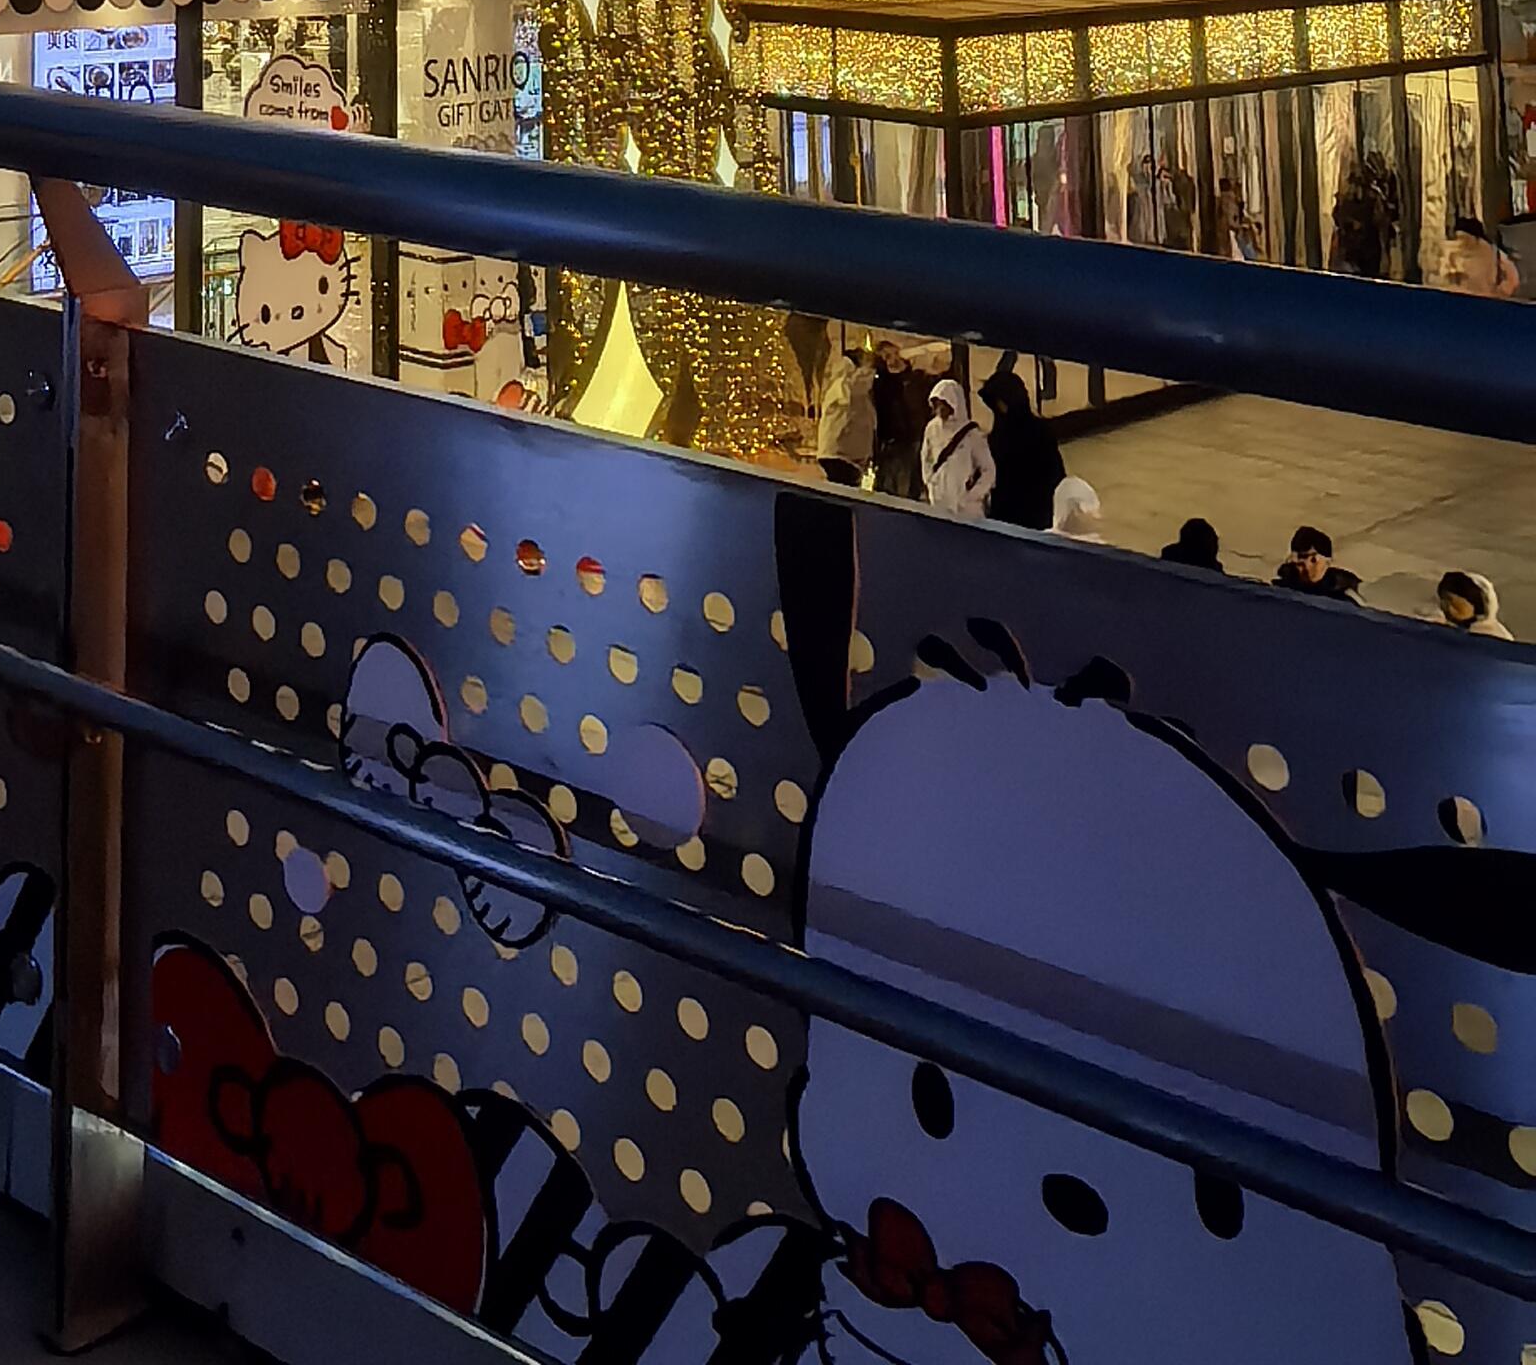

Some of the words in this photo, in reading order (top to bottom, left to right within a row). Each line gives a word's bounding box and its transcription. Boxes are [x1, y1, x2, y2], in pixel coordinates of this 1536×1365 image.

[269, 74, 321, 98] Smiles
[424, 51, 530, 98] SANRIO
[259, 104, 294, 118] come
[298, 101, 329, 122] from
[438, 101, 475, 127] GIFT
